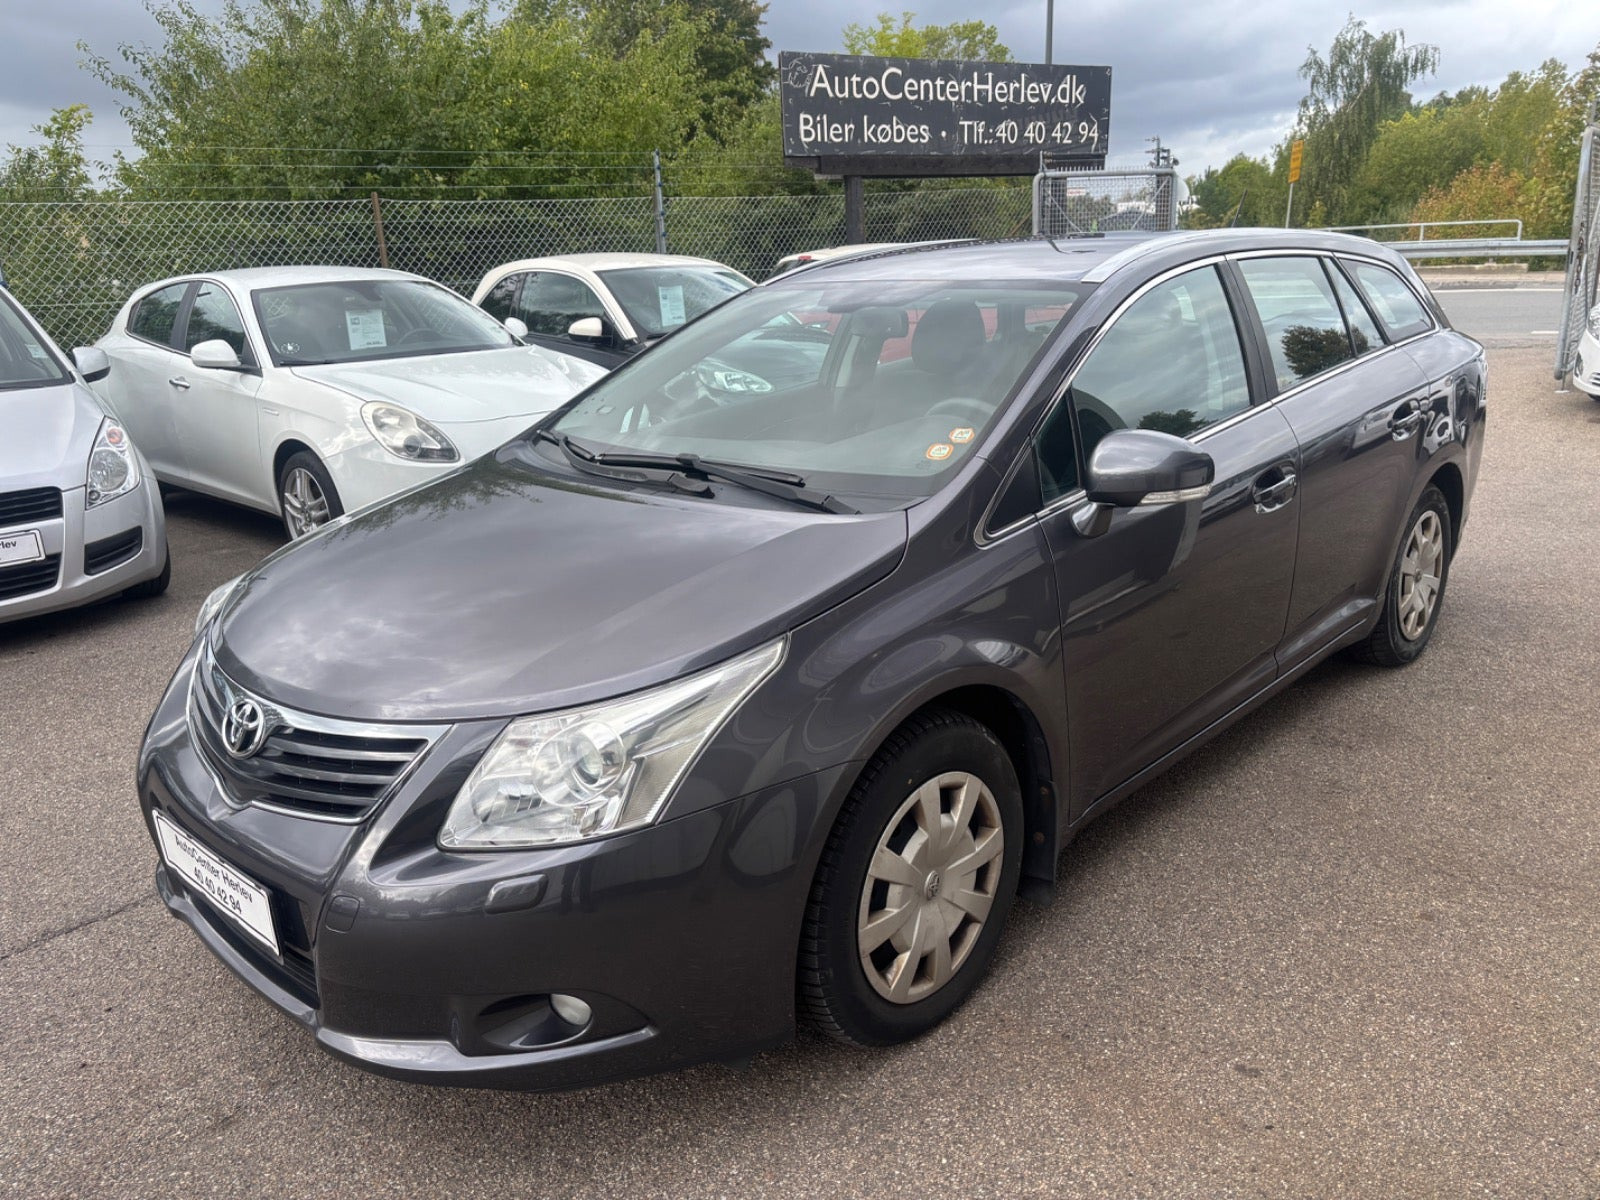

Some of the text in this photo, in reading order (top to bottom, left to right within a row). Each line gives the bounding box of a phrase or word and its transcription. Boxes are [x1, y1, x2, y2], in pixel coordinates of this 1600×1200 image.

[809, 64, 1084, 104] AutoCenterHerlev.dk
[799, 112, 854, 142] Biler
[863, 114, 930, 143] købes
[1023, 121, 1046, 144] 40
[1051, 121, 1072, 144] 42
[1078, 121, 1099, 144] 94
[194, 866, 242, 914] 40 40 42 94
[221, 869, 253, 903] Herlev
